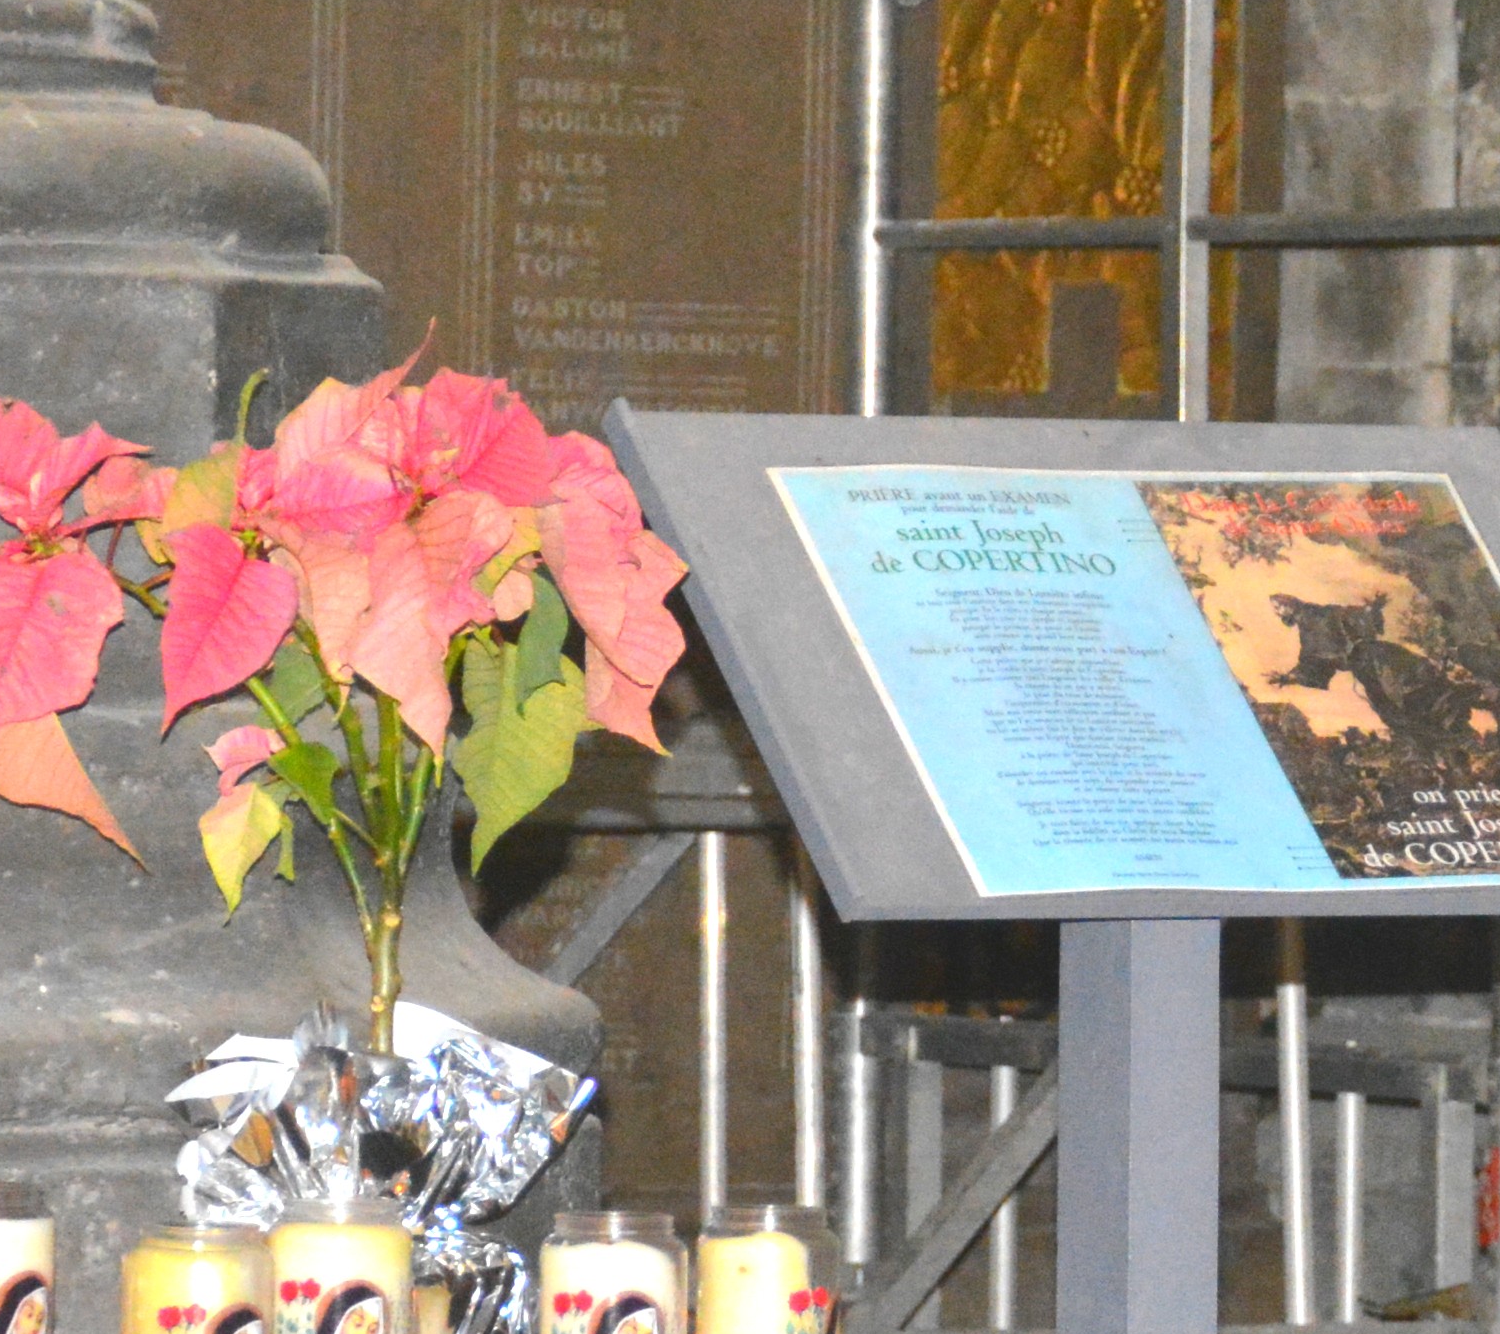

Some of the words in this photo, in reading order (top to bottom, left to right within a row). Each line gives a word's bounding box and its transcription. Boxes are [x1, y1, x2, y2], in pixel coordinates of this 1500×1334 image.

[896, 519, 966, 542] saint
[972, 519, 1065, 551] Joseph
[871, 551, 905, 574] de
[911, 548, 1117, 577] COPERTINO
[1412, 789, 1447, 804] on
[1386, 812, 1458, 836] saint
[1363, 843, 1396, 868] de
